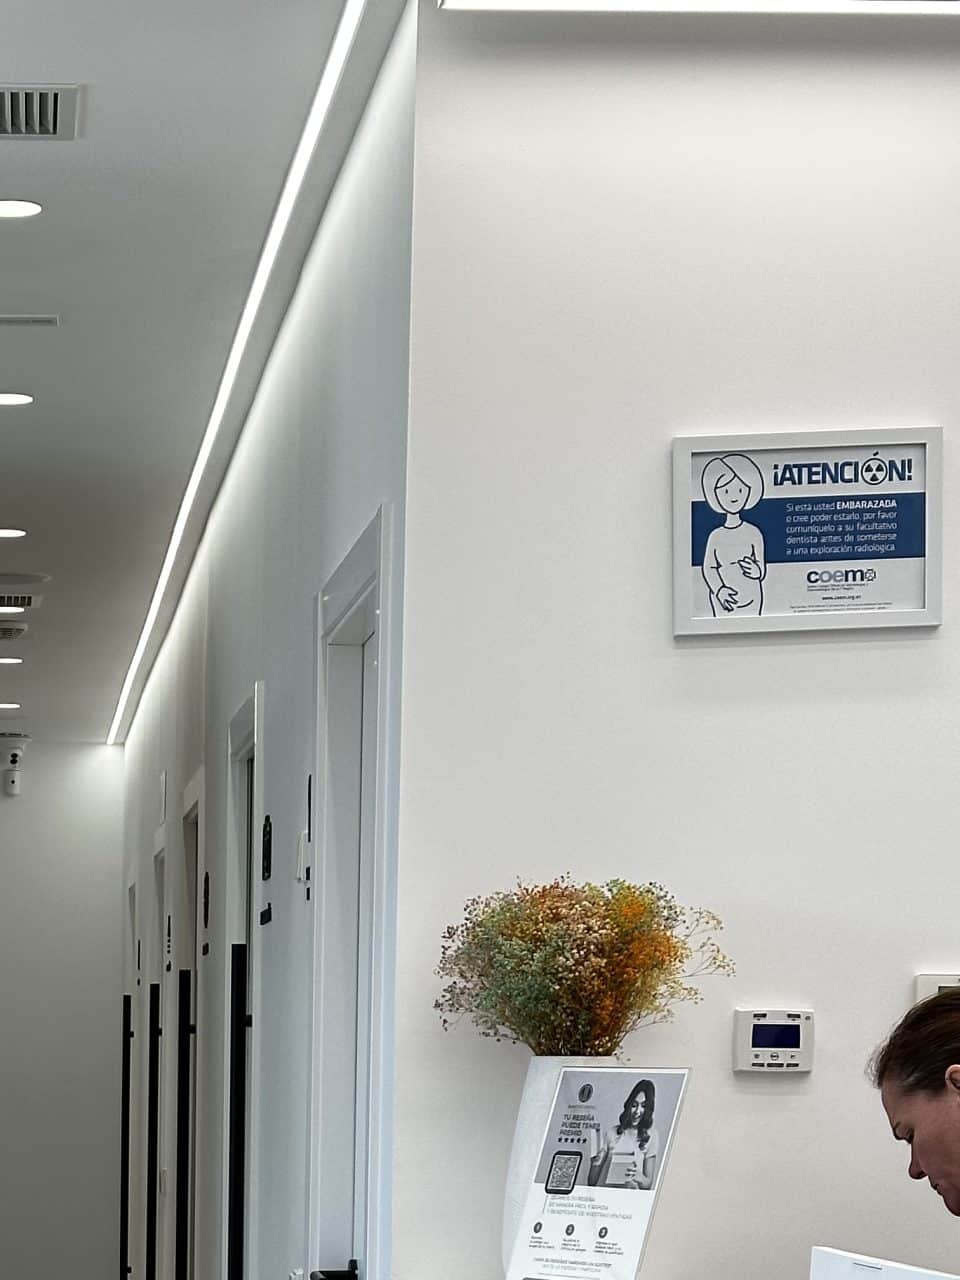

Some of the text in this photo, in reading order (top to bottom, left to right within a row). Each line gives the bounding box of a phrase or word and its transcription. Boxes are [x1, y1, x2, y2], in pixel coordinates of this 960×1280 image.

[814, 502, 835, 510] usted
[836, 500, 897, 510] EMBARAZADA
[810, 514, 832, 523] poder
[863, 512, 876, 522] por
[877, 511, 897, 519] favor
[857, 522, 897, 530] facultativo
[786, 536, 818, 544] dentista
[844, 534, 854, 542] de
[810, 545, 852, 555] exploración
